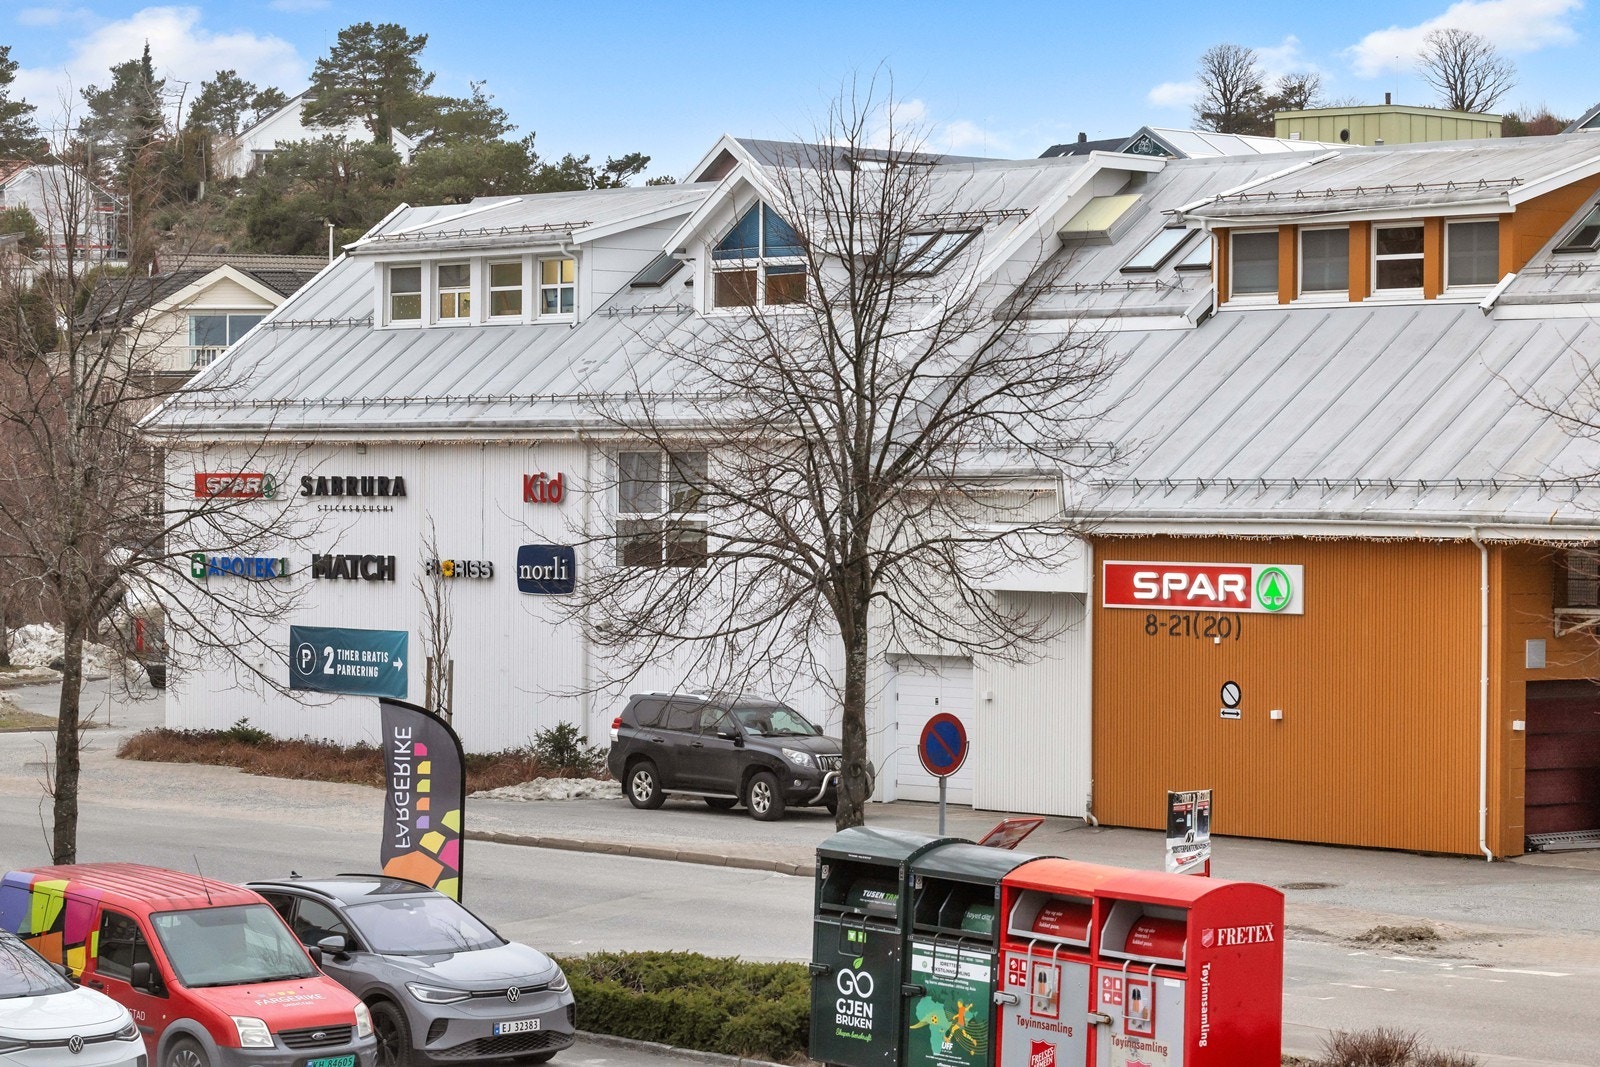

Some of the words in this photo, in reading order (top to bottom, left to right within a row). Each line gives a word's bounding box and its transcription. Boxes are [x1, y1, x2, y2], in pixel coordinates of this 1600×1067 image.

[205, 477, 262, 495] SPAR
[301, 475, 407, 498] SABRURA
[522, 472, 563, 504] Kid
[208, 557, 277, 578] APOTEK
[312, 554, 396, 581] MATCH
[519, 556, 568, 580] norli
[1133, 571, 1247, 602] SPAR
[323, 646, 335, 675] 2
[337, 649, 359, 661] TIMER
[361, 651, 389, 663] GRATIS
[336, 664, 379, 677] PARKERING
[1217, 924, 1275, 946] FRETEX
[836, 968, 874, 998] GO
[254, 993, 327, 1006] FARGERIKE
[836, 998, 873, 1019] GJEN
[1199, 962, 1211, 1048] Tøyinnsamling
[502, 1024, 511, 1033] EJ
[515, 1020, 538, 1031] 32383
[836, 1013, 873, 1030] BRUKEN
[1016, 1014, 1073, 1037] Tøyinnsamling
[1111, 1034, 1168, 1057] Tøyinnsamling
